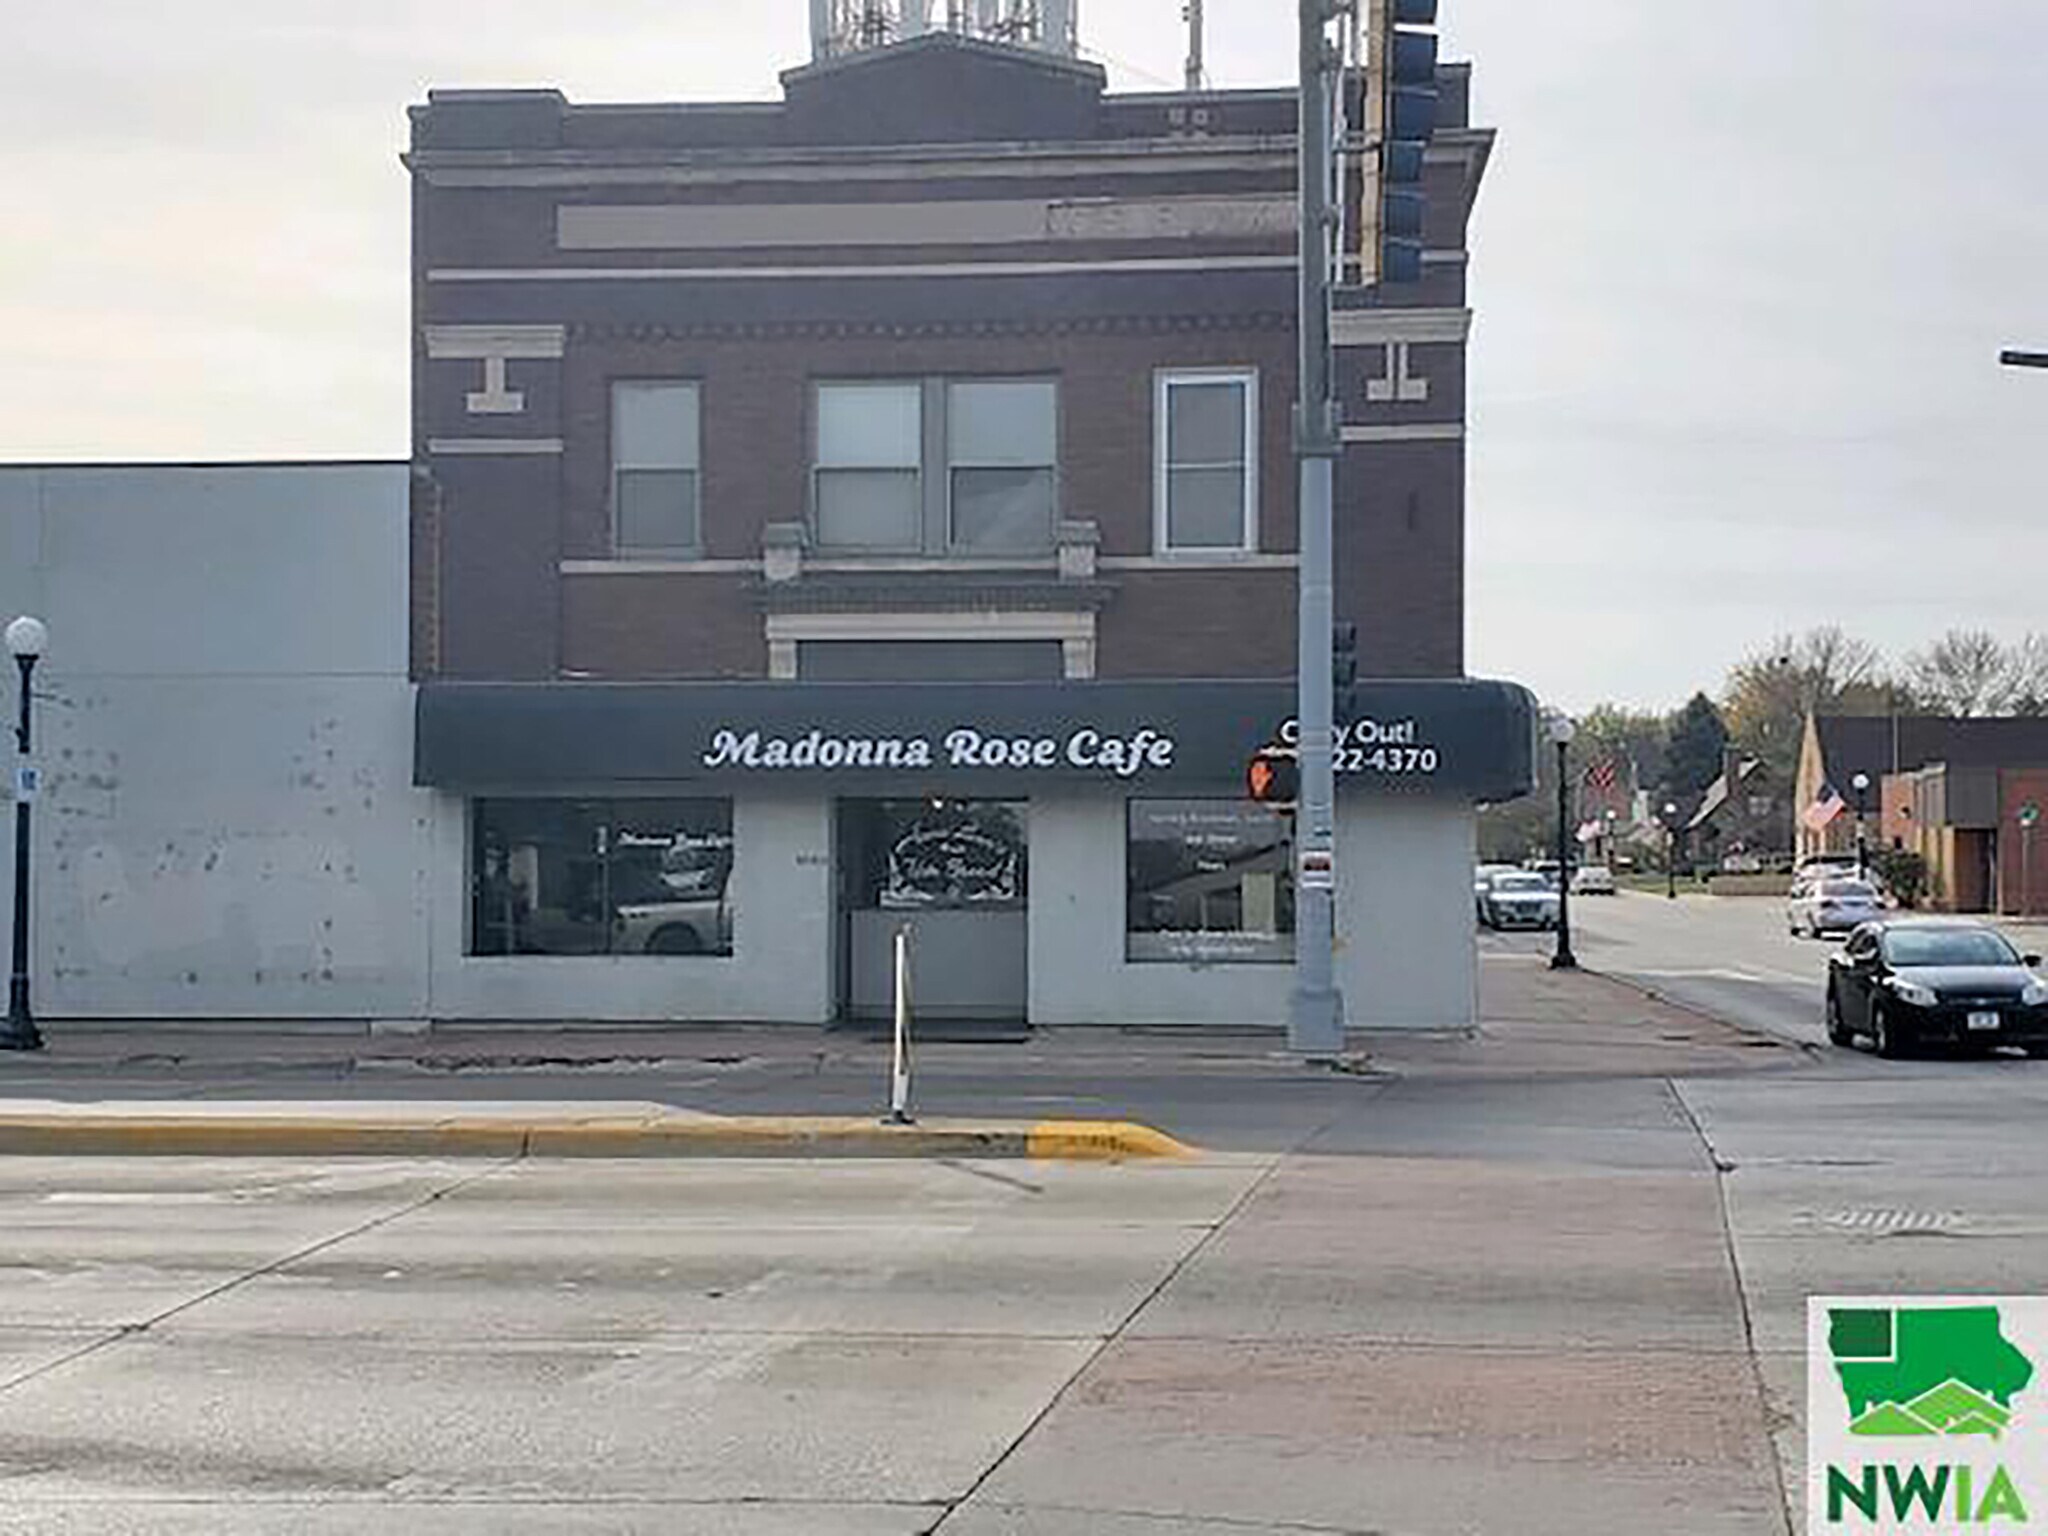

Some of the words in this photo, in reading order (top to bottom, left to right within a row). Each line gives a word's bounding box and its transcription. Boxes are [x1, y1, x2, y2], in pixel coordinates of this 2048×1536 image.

[1355, 719, 1414, 744] Out!
[704, 730, 931, 767] Madonna
[945, 729, 1056, 767] Rose
[1066, 729, 1173, 775] Cafe
[1330, 748, 1437, 772] 22-4370
